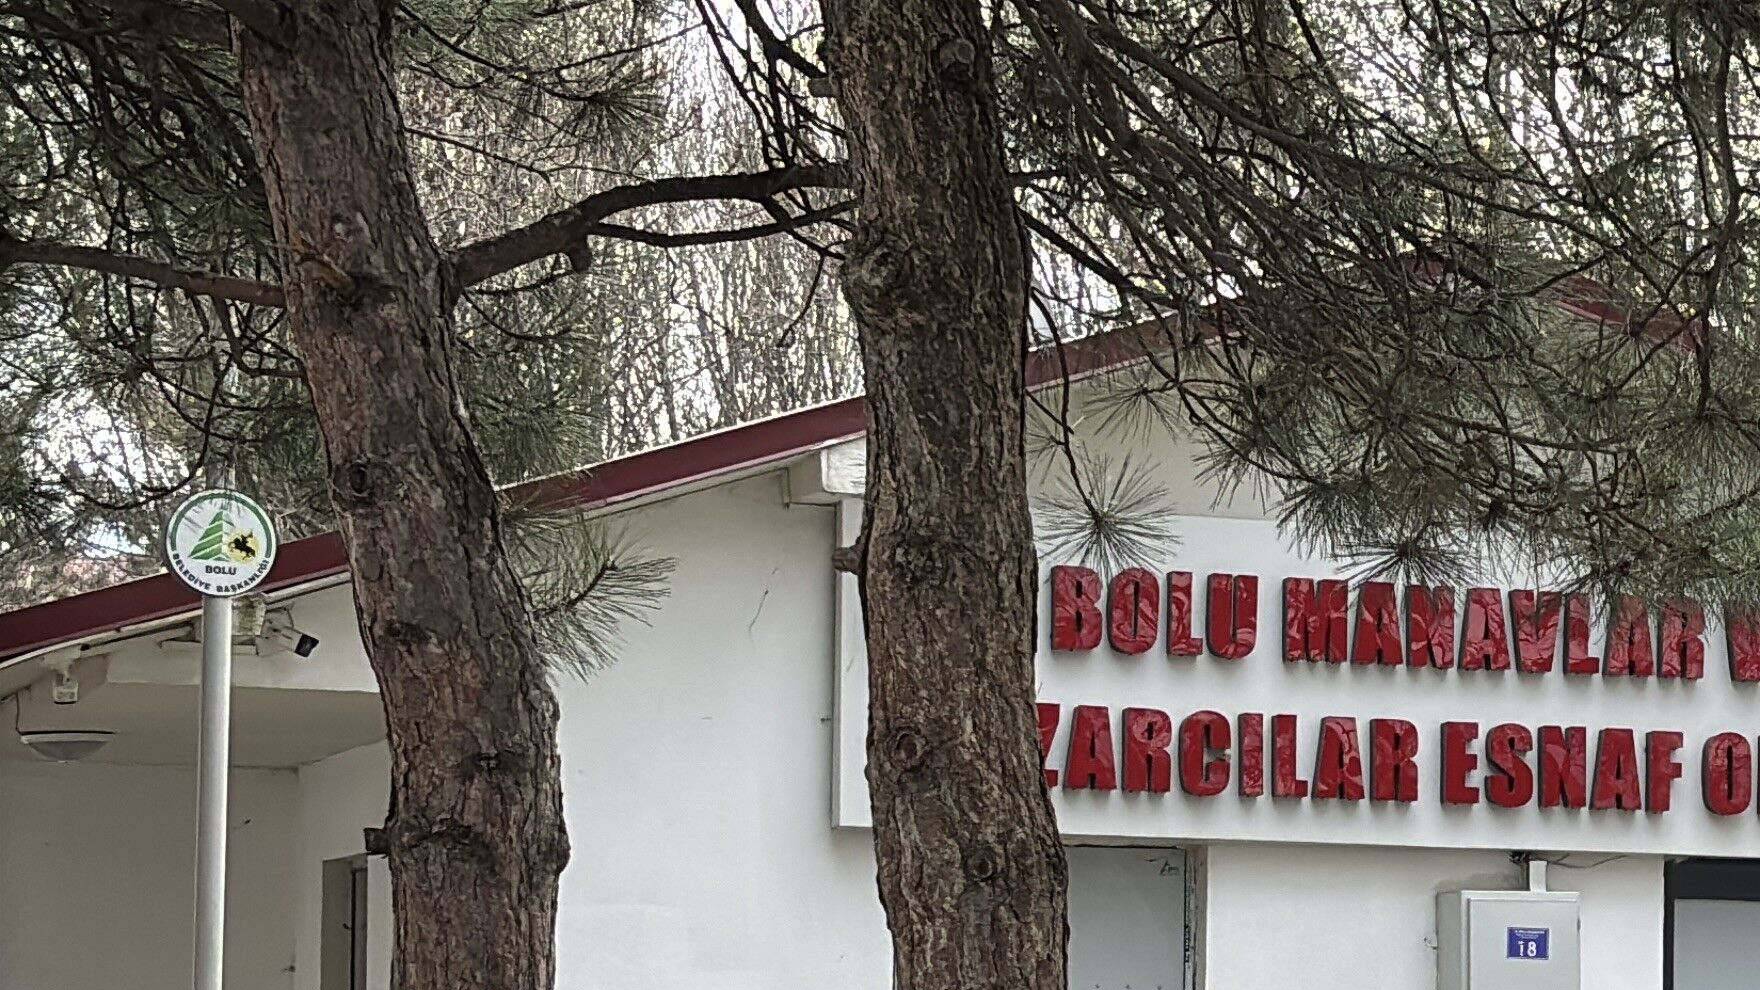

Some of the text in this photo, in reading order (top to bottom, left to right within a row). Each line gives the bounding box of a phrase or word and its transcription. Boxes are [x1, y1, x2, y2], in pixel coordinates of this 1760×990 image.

[172, 553, 211, 590] BELEDİYE
[205, 565, 237, 575] BOLU
[1050, 564, 1258, 659] BOLU
[1282, 577, 1704, 680] MANAVLAR
[1036, 702, 1418, 802] ZARCILAR
[1440, 721, 1684, 814] ESNAF
[1517, 941, 1537, 957] 18
